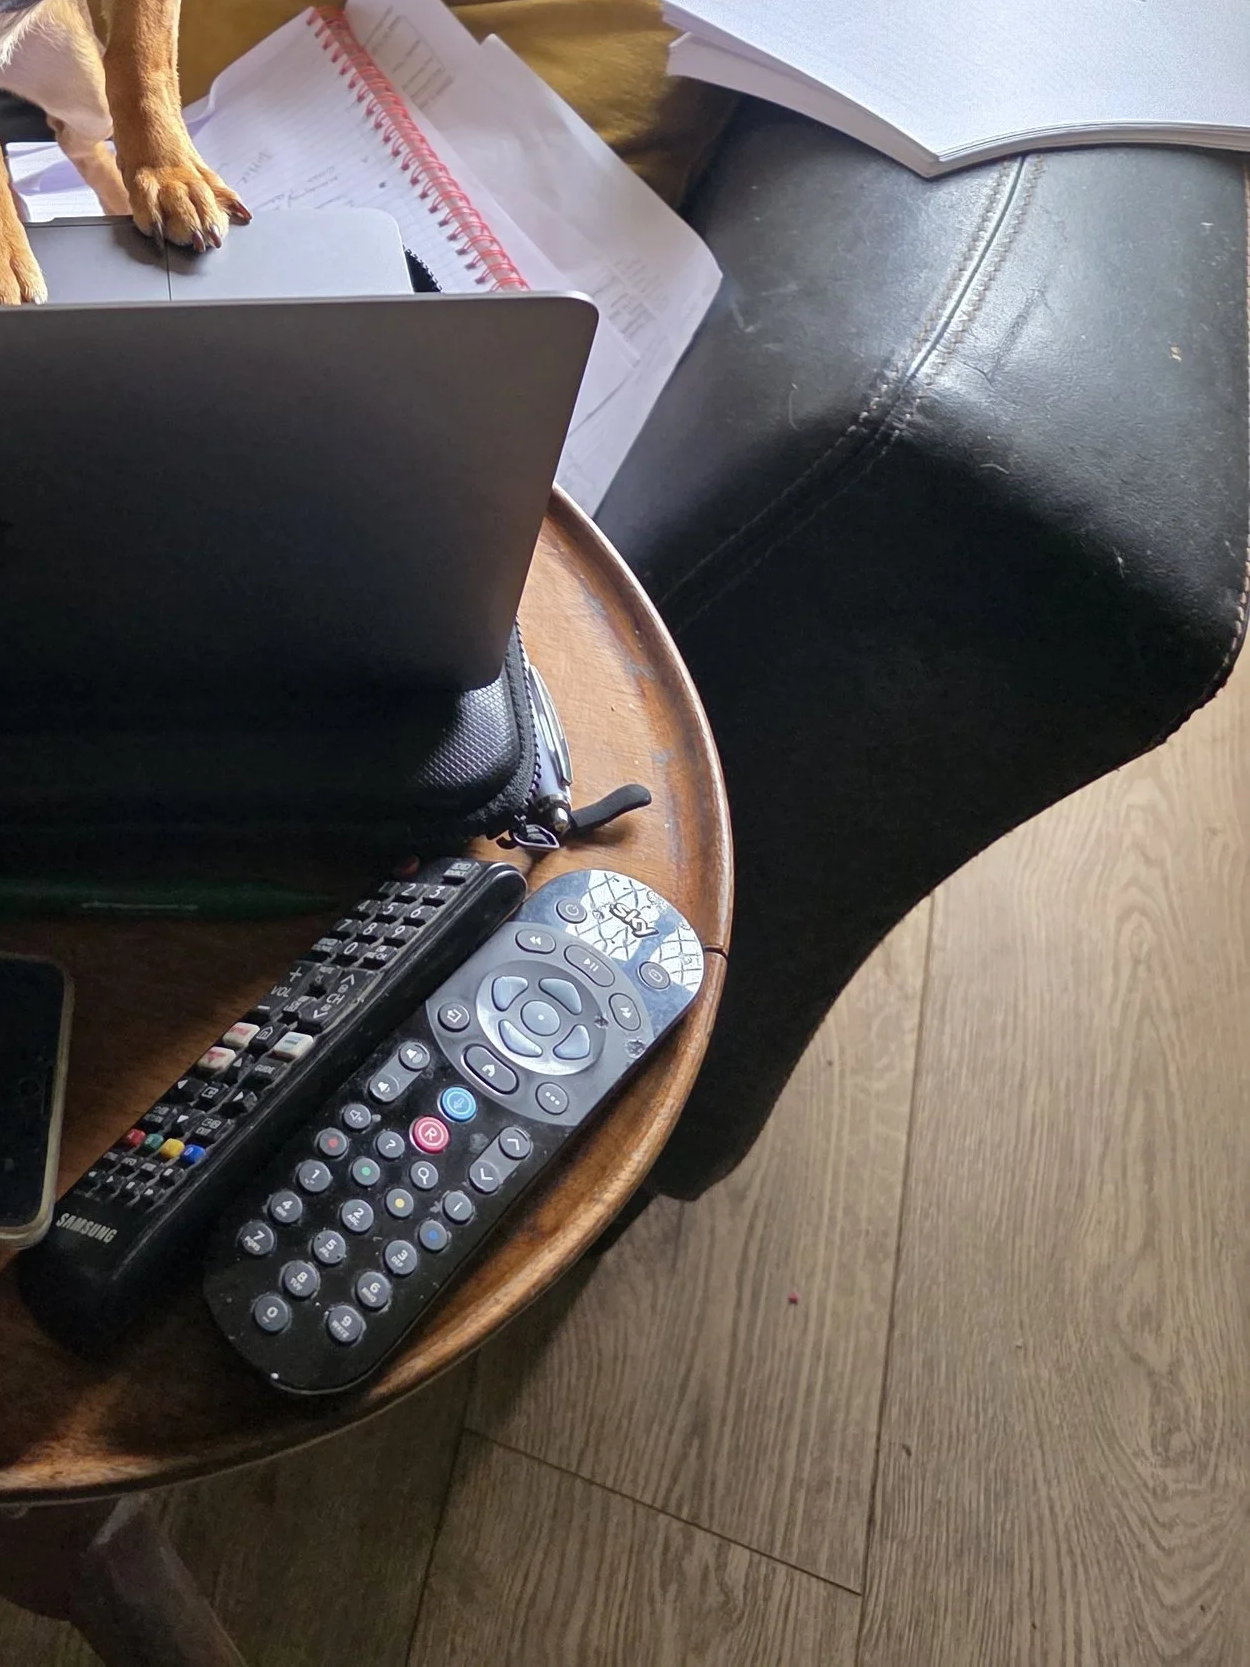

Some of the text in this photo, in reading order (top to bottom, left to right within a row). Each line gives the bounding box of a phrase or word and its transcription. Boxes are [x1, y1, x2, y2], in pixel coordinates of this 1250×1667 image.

[401, 883, 416, 896] 2
[429, 885, 446, 898] 3
[357, 899, 371, 911] 4
[382, 902, 399, 915] 5
[410, 906, 425, 918] 6
[336, 918, 353, 931] 7
[610, 902, 659, 938] sky
[362, 922, 378, 935] 8
[391, 925, 406, 938] 9
[343, 941, 359, 955] 0
[270, 985, 292, 998] VOL
[326, 993, 346, 1005] CH
[254, 1064, 277, 1075] GUIDE
[425, 1127, 438, 1141] R
[311, 1169, 321, 1179] 1
[282, 1199, 293, 1210] 4
[353, 1207, 364, 1219] 2
[56, 1212, 118, 1244] SAMSUNG
[253, 1230, 266, 1240] 7
[326, 1239, 337, 1251] 5
[397, 1249, 409, 1262] 3
[296, 1271, 309, 1283] 8
[369, 1282, 381, 1294] 6
[266, 1306, 279, 1319] 0
[341, 1315, 353, 1327] 9
